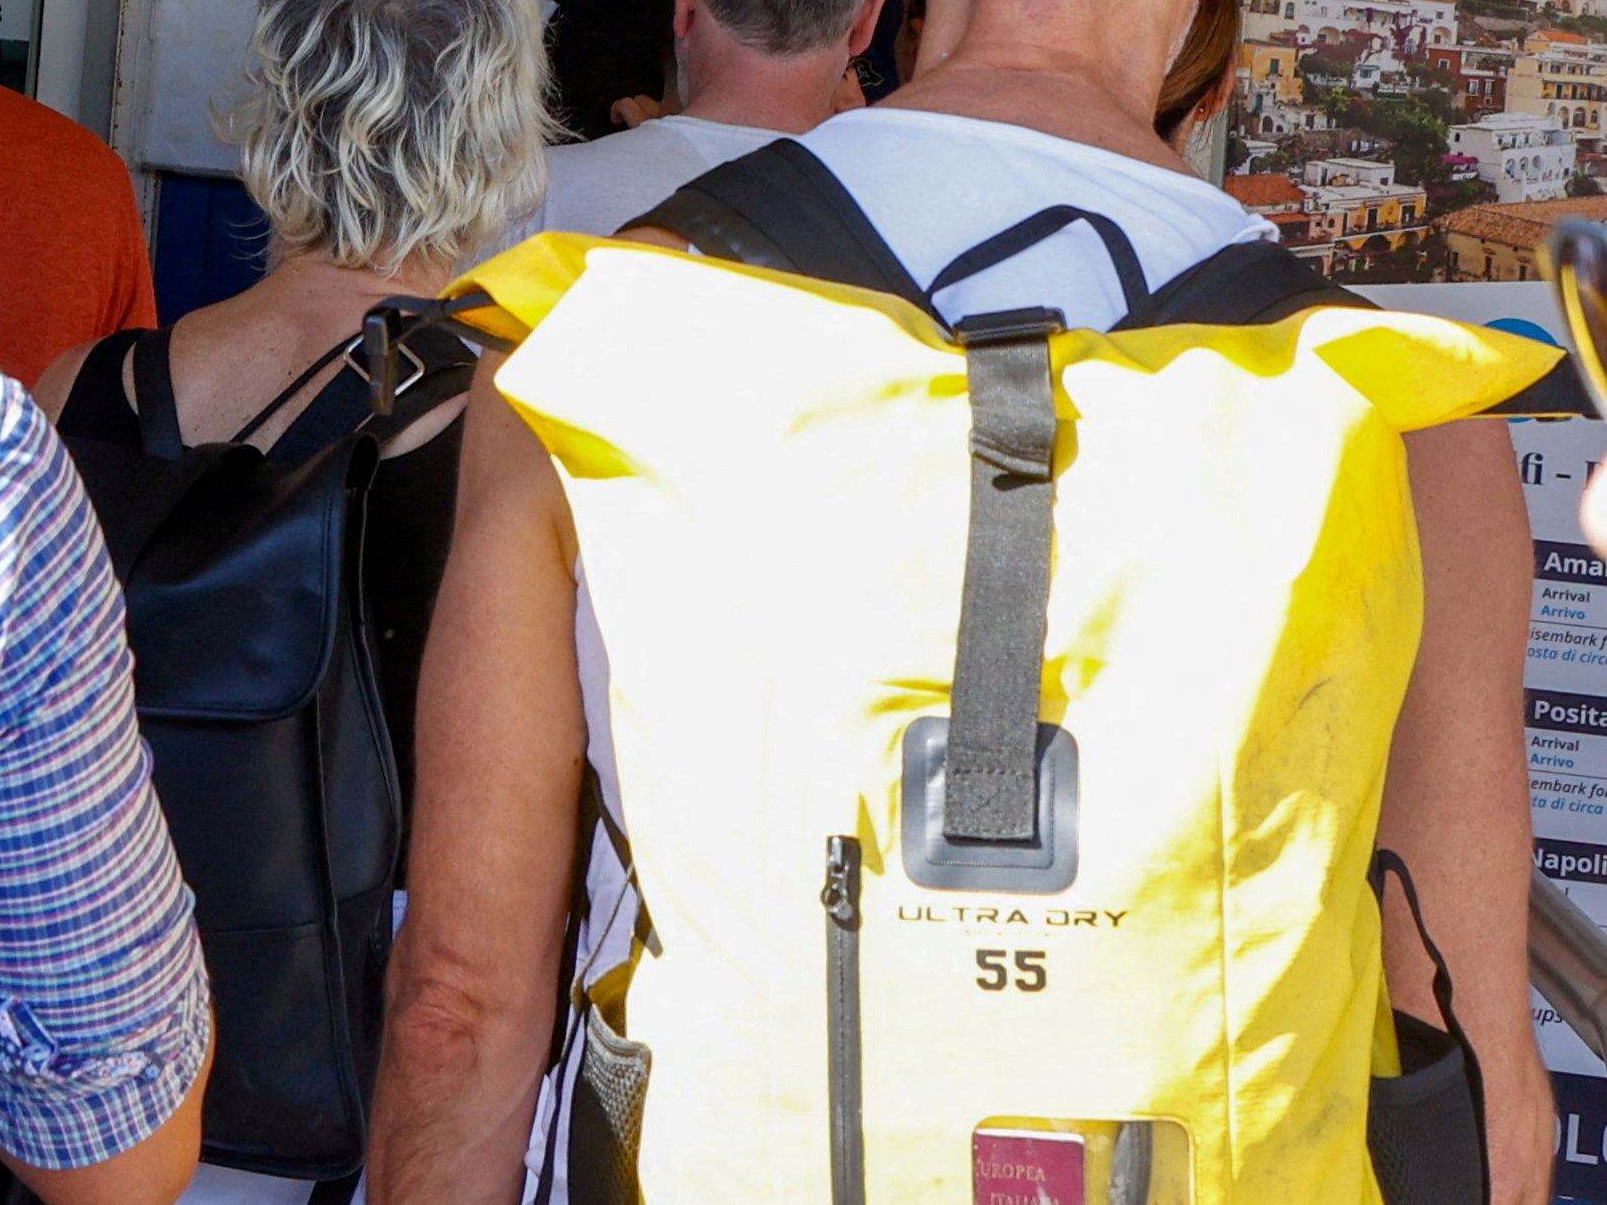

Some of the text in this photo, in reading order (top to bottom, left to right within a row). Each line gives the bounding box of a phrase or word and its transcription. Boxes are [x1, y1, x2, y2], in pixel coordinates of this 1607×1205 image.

[1542, 587, 1591, 603] Arrival
[1541, 605, 1586, 620] Arrivo
[1562, 649, 1577, 662] di
[1580, 651, 1607, 666] circ
[1531, 736, 1580, 752] Arrival
[1530, 754, 1574, 768] Arrivo
[1529, 779, 1607, 799] embark fo
[1551, 798, 1566, 811] di
[1569, 800, 1604, 815] circa
[898, 906, 1131, 927] ULTRA DRY
[975, 948, 1047, 992] 55
